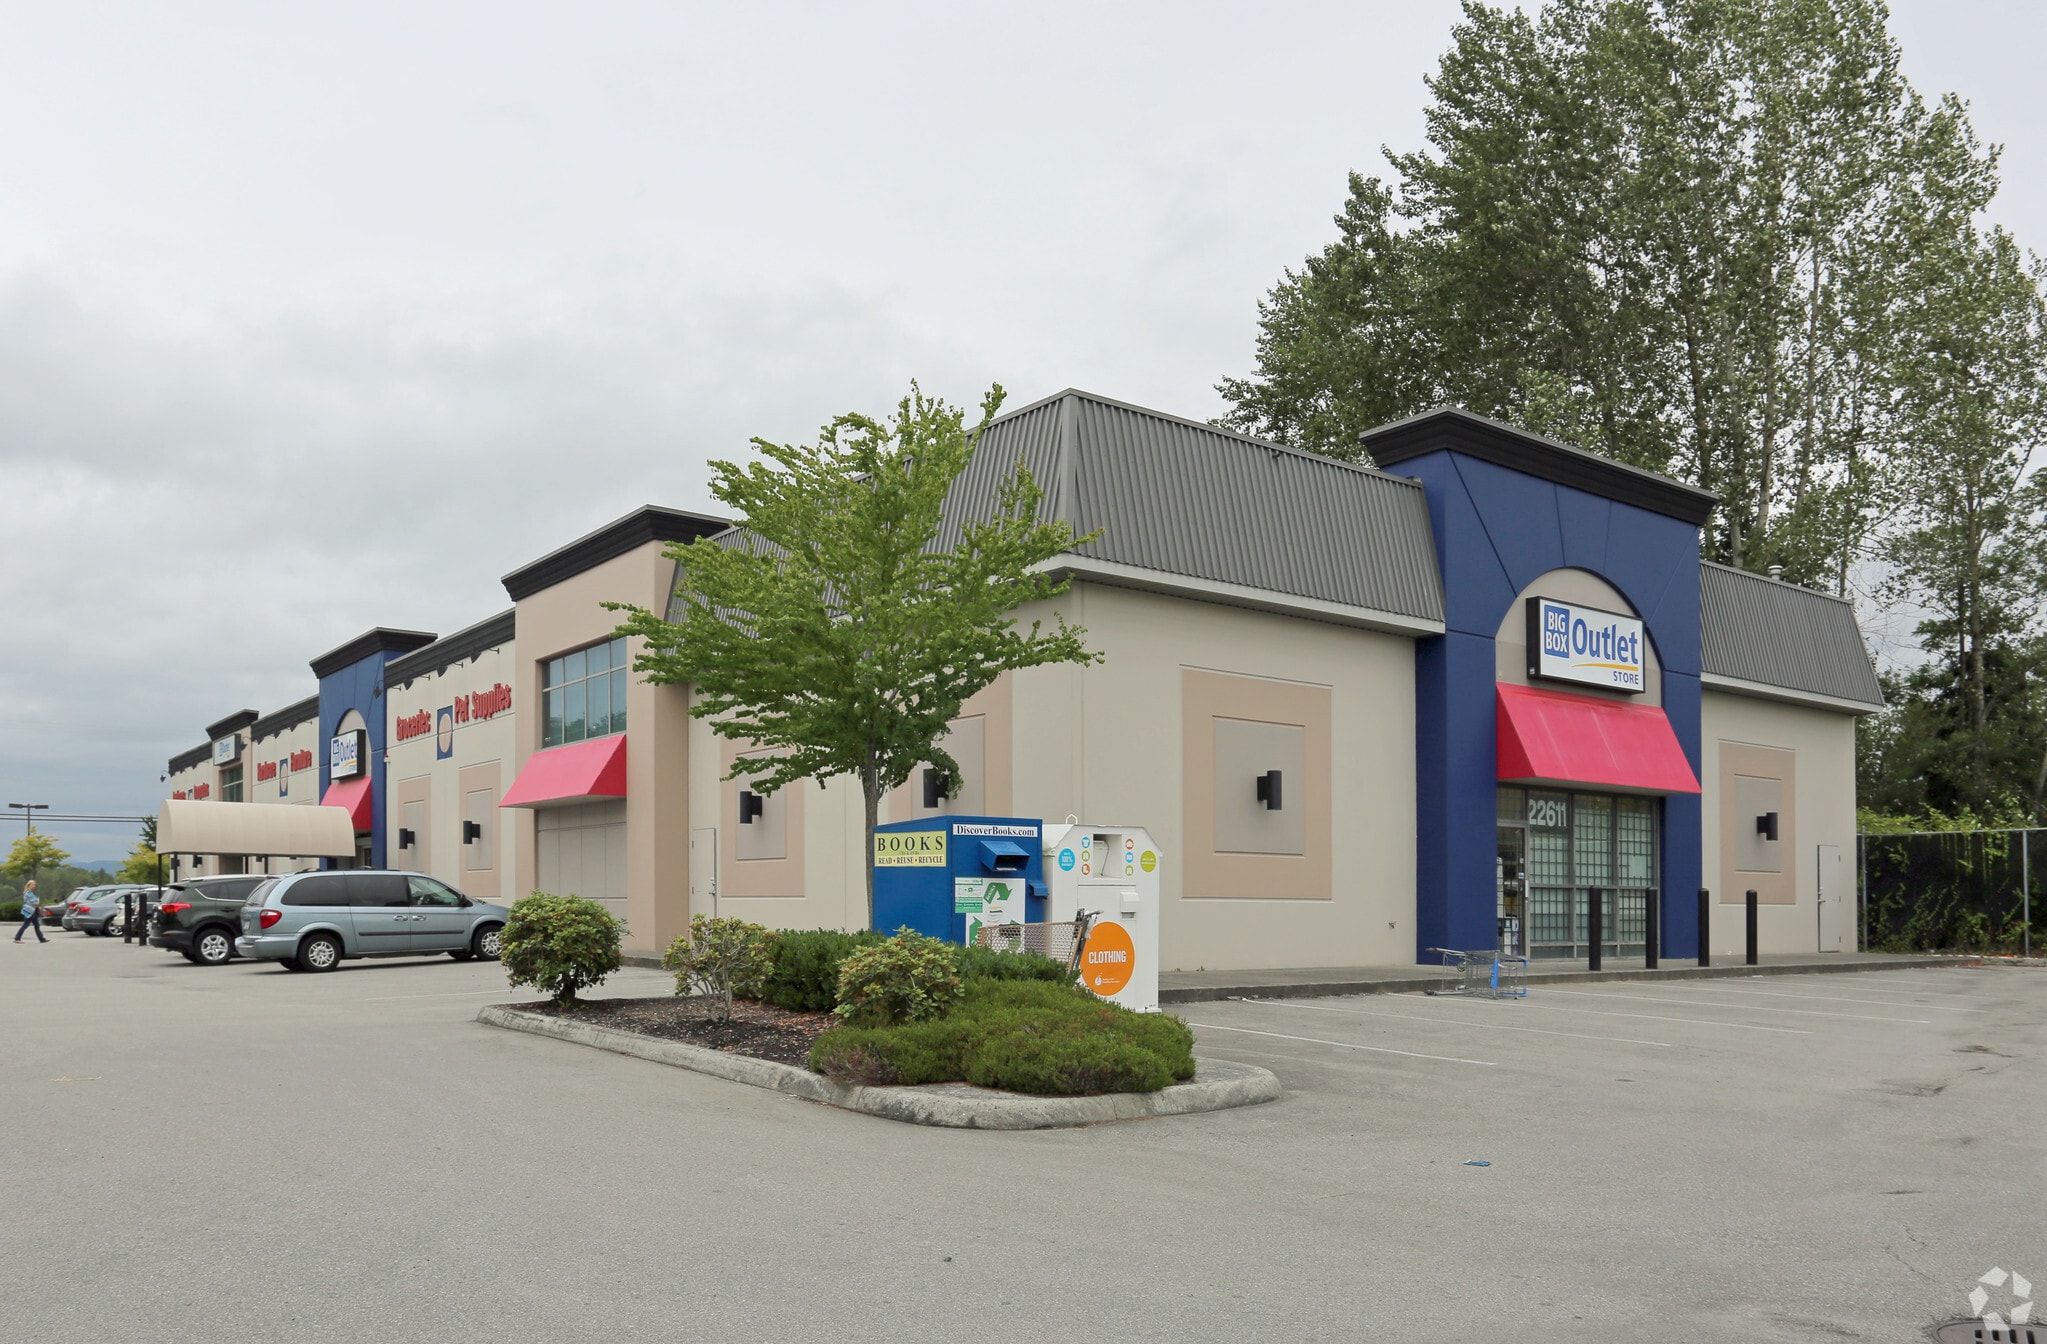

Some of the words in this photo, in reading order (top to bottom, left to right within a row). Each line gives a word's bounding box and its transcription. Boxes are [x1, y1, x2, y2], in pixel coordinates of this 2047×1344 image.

[1547, 611, 1566, 632] BIG
[1545, 632, 1568, 653] BOX
[1572, 618, 1639, 665] Outlet
[1613, 670, 1639, 685] STORE
[454, 695, 469, 724] Pet
[472, 682, 512, 720] Supplies
[396, 708, 431, 741] Groceries
[339, 738, 357, 762] Outlet
[1528, 798, 1567, 827] 22611
[956, 825, 1035, 837] DiscoverBooks.com
[877, 835, 943, 852] BOOKS
[878, 857, 893, 865] READ
[896, 856, 914, 864] REUSE
[918, 855, 943, 864] RECYCLE
[1088, 950, 1127, 964] CLOTHING
